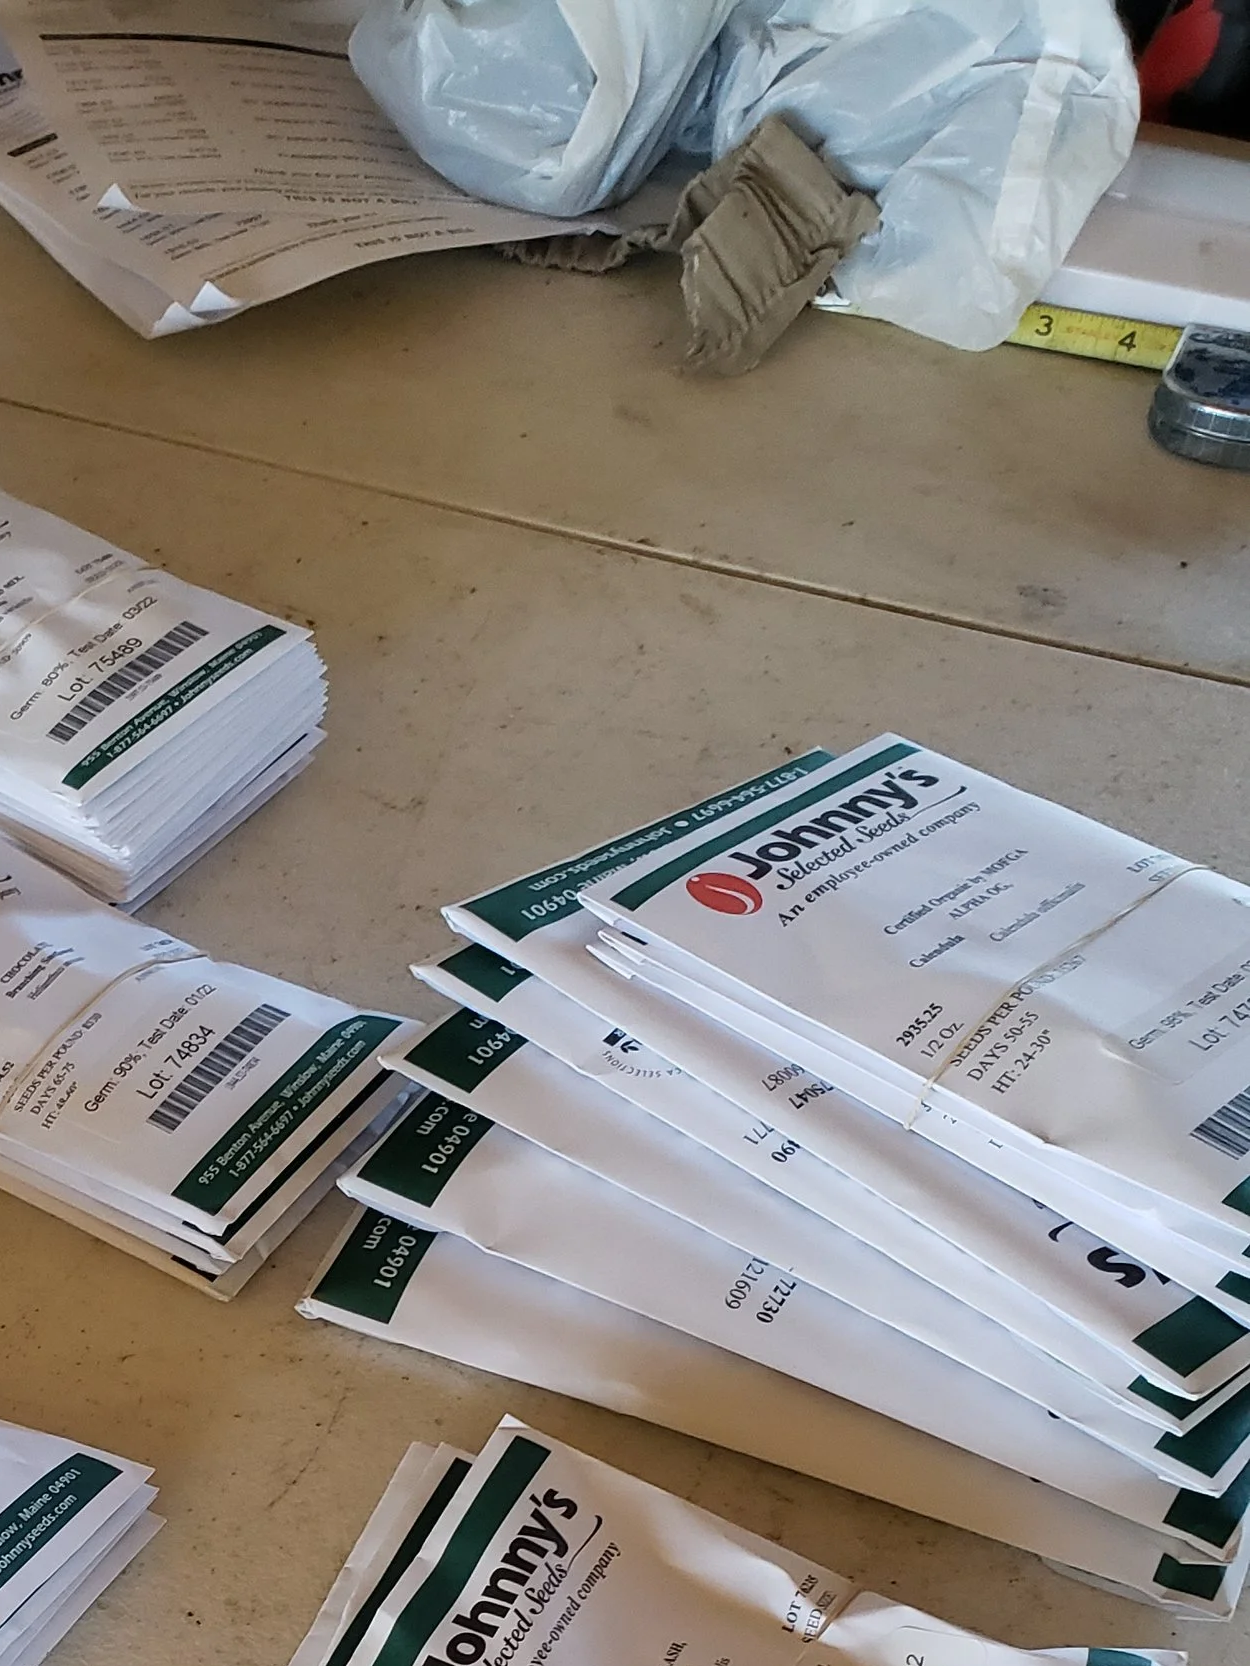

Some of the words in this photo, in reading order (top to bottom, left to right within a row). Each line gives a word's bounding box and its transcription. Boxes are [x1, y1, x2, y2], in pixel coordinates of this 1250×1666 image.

[1035, 315, 1054, 336] 3
[1118, 331, 1137, 352] 4
[66, 639, 98, 660] Test
[120, 595, 158, 620] 03/22
[87, 635, 146, 674] 75489
[692, 767, 809, 821] 1-877-564-6697
[728, 767, 942, 880] Johnny's
[521, 882, 578, 921] 04901
[882, 903, 935, 935] Certified
[926, 880, 976, 907] Organic
[965, 873, 989, 885] by
[978, 847, 1031, 876] MOFGA
[944, 893, 993, 920] ALPHA
[904, 933, 968, 968] Calendula
[136, 1027, 168, 1051] Test
[159, 1003, 192, 1029] Date:
[183, 982, 216, 1007] 01/22
[893, 1002, 946, 1045] 2935.25
[134, 1068, 176, 1099] Lot:
[161, 1024, 218, 1070] 74834
[964, 1042, 1011, 1080] DAYS
[1000, 1010, 1041, 1042] 50-55
[422, 1125, 470, 1174] 04901
[374, 1235, 417, 1288] 04901
[756, 1278, 797, 1324] 72730
[522, 1563, 568, 1616] Seeds
